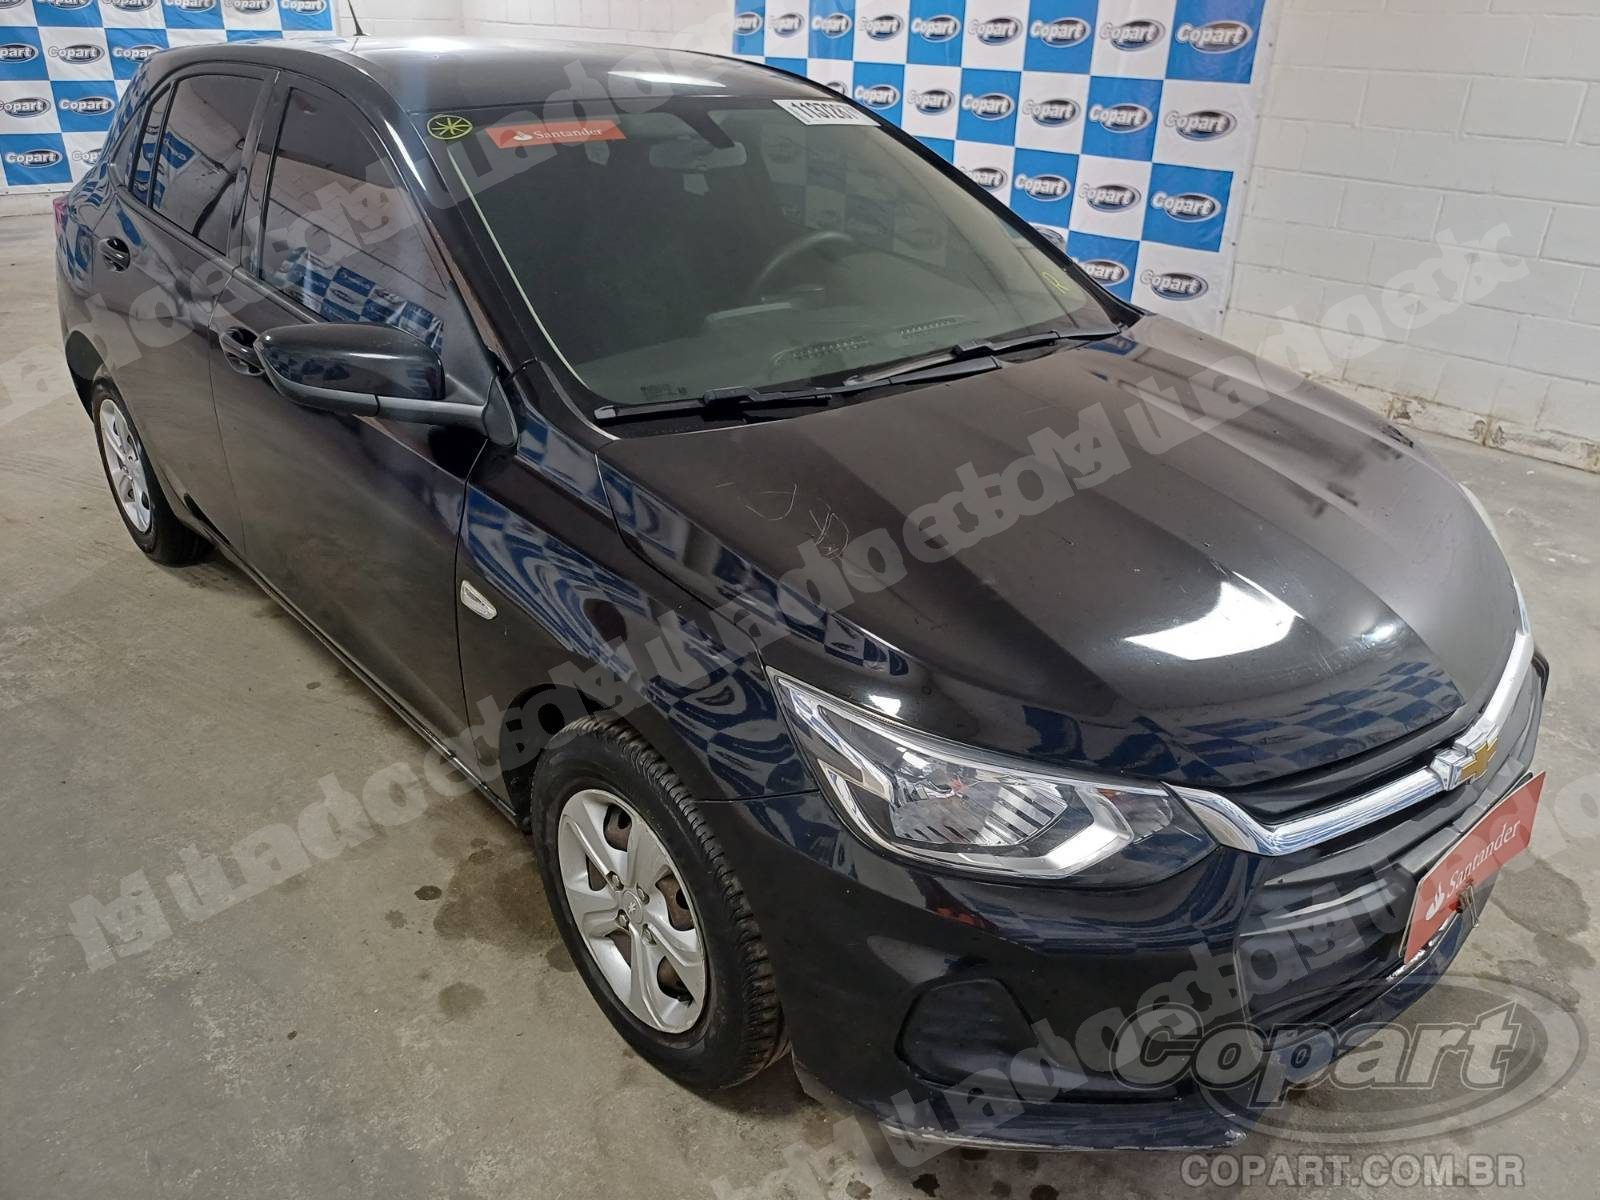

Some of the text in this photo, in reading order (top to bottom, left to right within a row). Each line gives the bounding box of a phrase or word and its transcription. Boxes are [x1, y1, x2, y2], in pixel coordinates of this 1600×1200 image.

[811, 15, 847, 35] Copart
[858, 16, 898, 38] Copart
[911, 17, 955, 38] Copart
[967, 19, 1017, 41] Copart
[1030, 20, 1084, 43] Copart
[1099, 22, 1154, 46] Copart
[1175, 23, 1244, 49] Copart
[48, 46, 97, 61] Copart
[59, 99, 109, 112] Copart
[854, 85, 893, 108] Copart
[906, 90, 949, 112] Copart
[962, 93, 1009, 117] Copart
[1022, 99, 1074, 122] Copart
[1089, 104, 1145, 129] Copart
[533, 127, 602, 139] Santander
[1164, 111, 1227, 135] Copart
[6, 151, 57, 165] Copart
[72, 151, 101, 164] Cop
[1015, 174, 1066, 197] Copart
[1078, 182, 1134, 206] Copart
[1152, 191, 1214, 216] Copart
[1140, 269, 1198, 294] Copart
[1447, 820, 1521, 898] Santander
